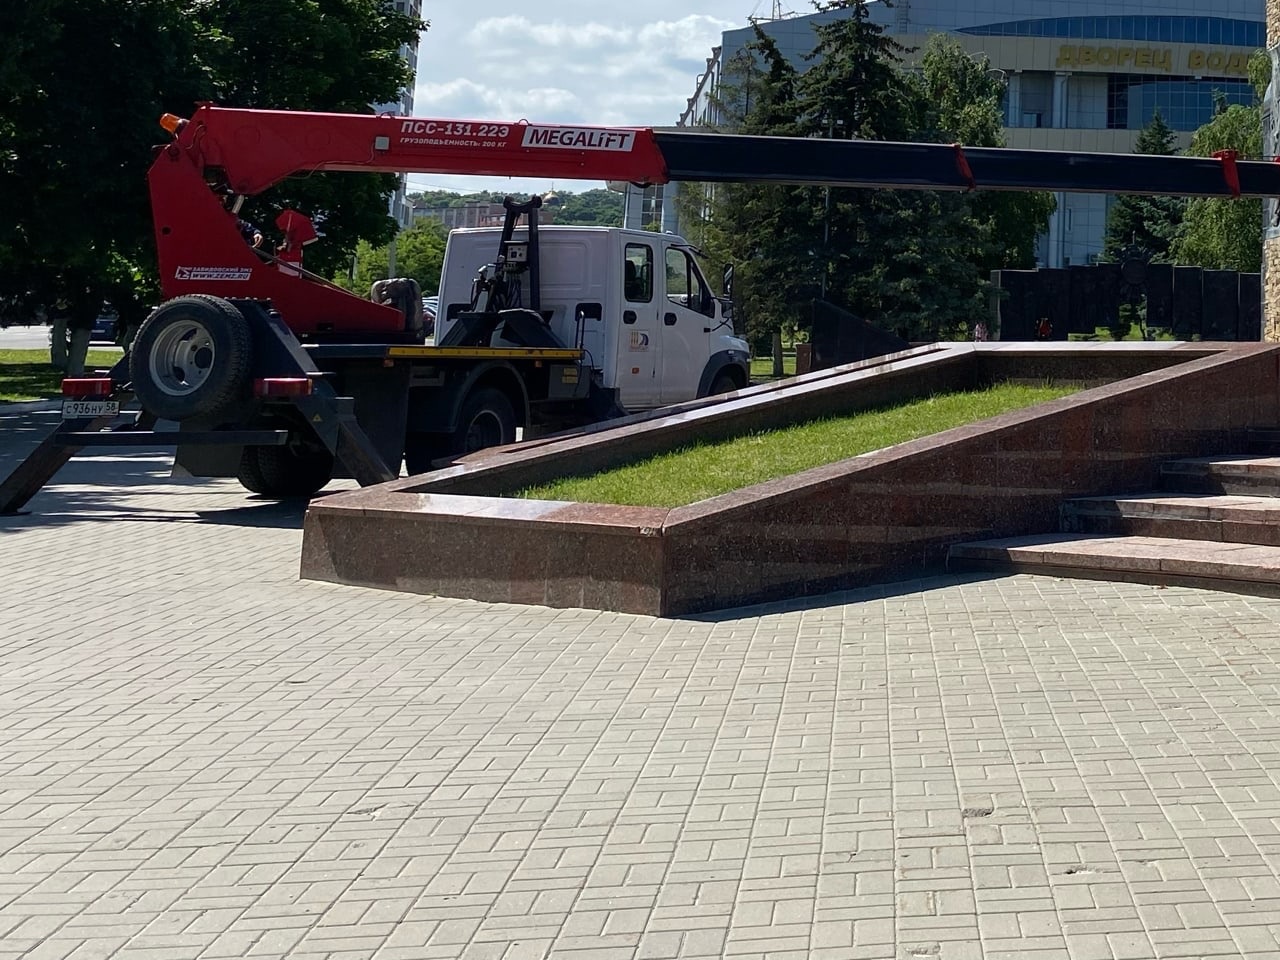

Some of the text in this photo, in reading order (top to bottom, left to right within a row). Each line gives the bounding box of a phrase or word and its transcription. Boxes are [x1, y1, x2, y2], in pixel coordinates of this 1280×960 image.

[1056, 45, 1249, 74] ДВОРЕЦ ВОД
[401, 121, 510, 138] ПСС-131.22Э
